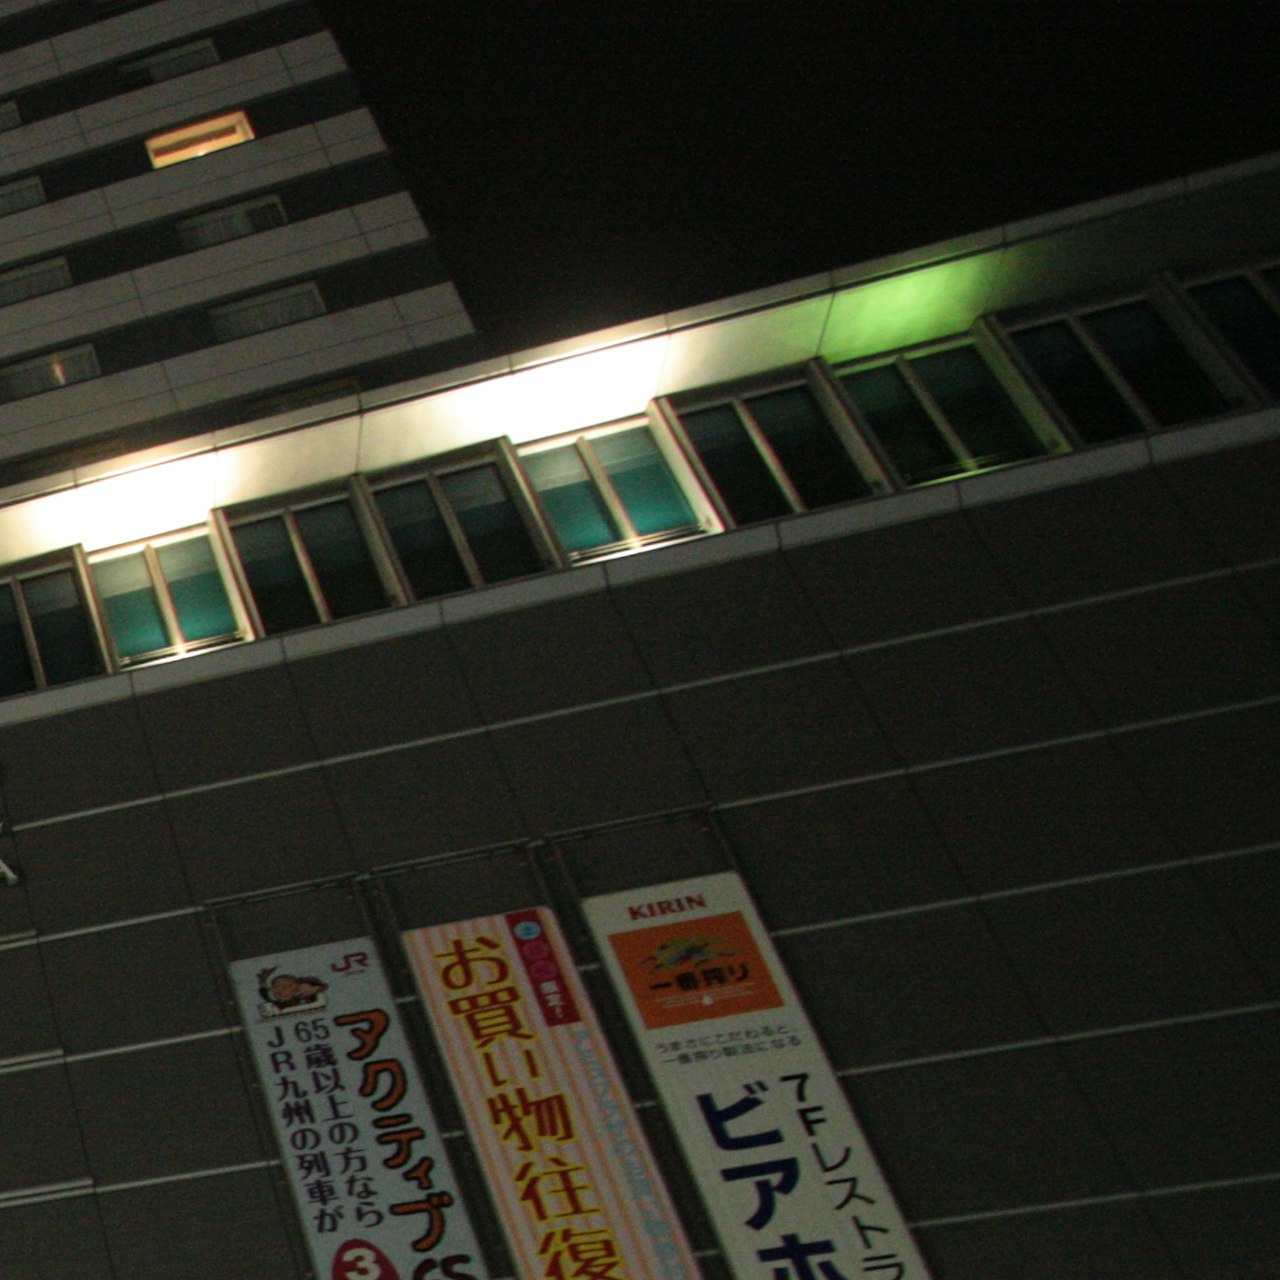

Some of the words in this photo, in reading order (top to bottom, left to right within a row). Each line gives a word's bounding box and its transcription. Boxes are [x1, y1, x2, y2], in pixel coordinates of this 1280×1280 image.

[331, 952, 370, 974] JR
[626, 893, 707, 921] KIRIN
[267, 1026, 345, 1234] JR九州の列車が
[293, 1017, 385, 1229] 65歳以上の方なら
